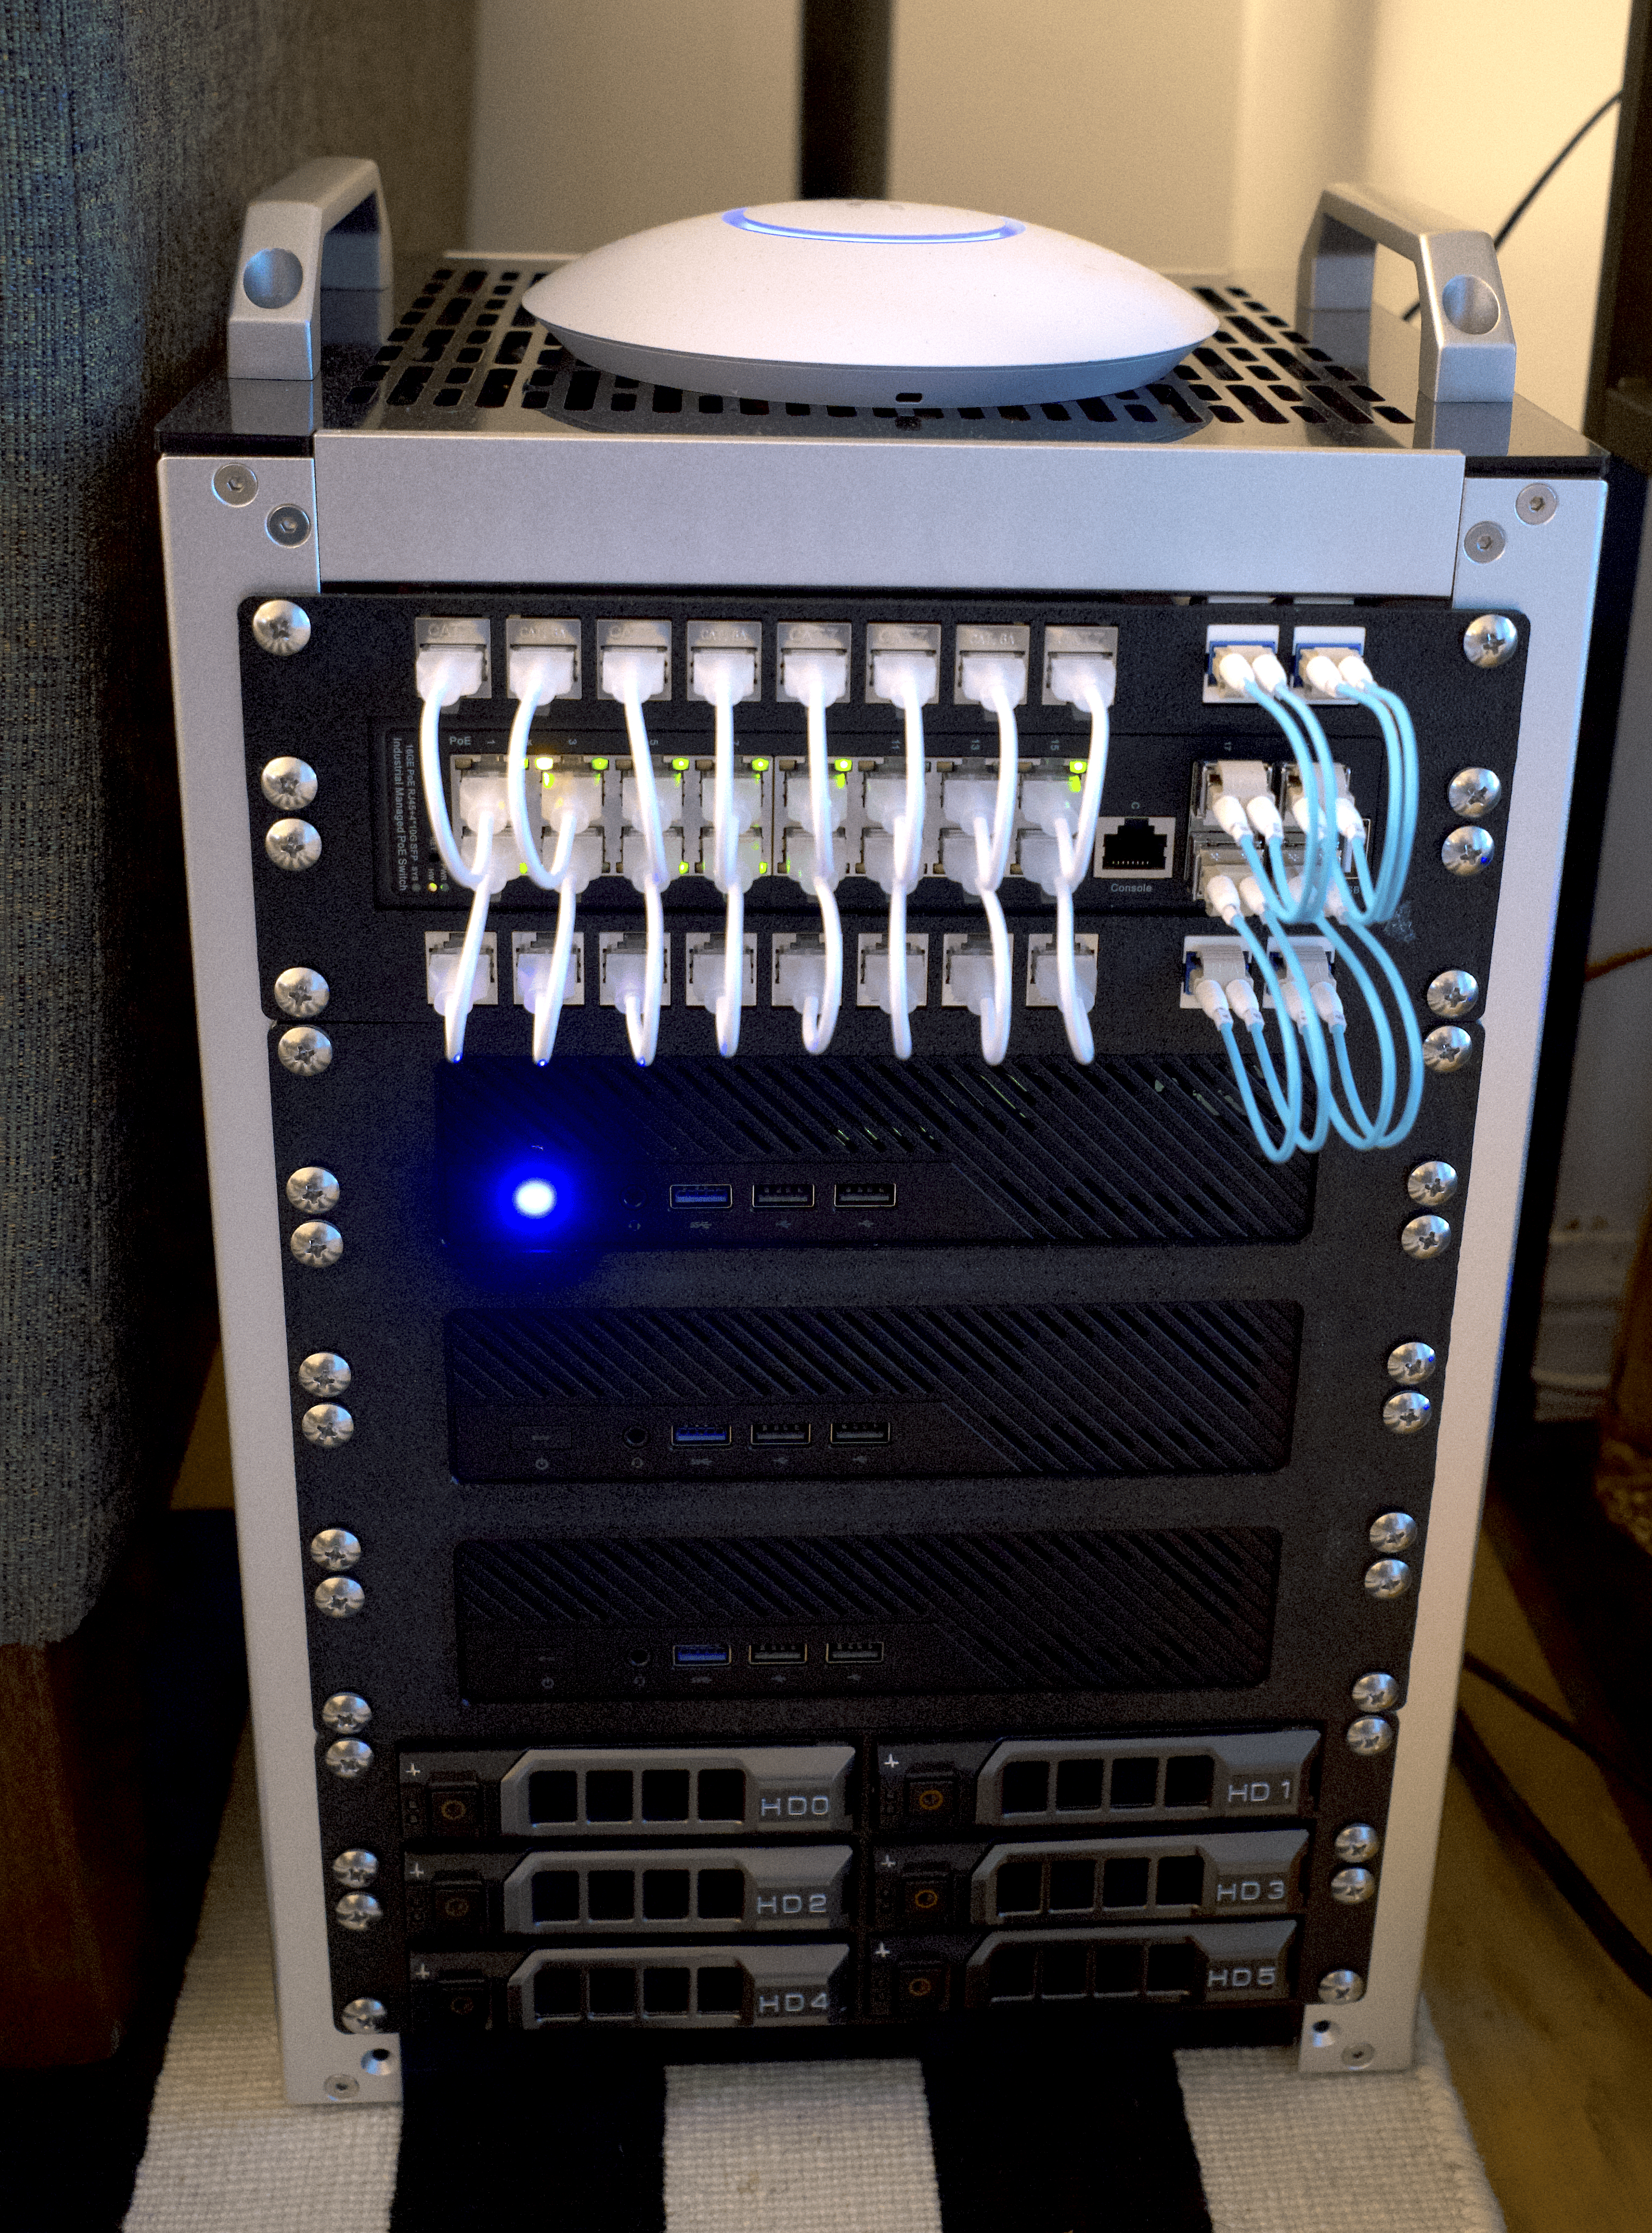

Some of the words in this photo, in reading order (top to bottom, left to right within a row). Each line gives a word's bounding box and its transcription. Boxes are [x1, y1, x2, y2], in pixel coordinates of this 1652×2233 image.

[449, 735, 472, 746] PoE
[650, 738, 659, 746] 5
[891, 739, 900, 749] 11
[970, 739, 980, 750] 13
[1049, 739, 1060, 751] 15
[393, 737, 404, 785] Industrial
[405, 744, 414, 767] 16GE
[406, 769, 416, 786] PoE
[394, 787, 405, 833] Managed
[397, 835, 407, 856] PoE
[410, 843, 419, 862] SFP
[398, 858, 408, 891] Switch
[411, 866, 419, 882] SYS
[1111, 883, 1152, 892] Console
[761, 1795, 830, 1816] HD0
[1207, 1966, 1277, 1988] HD5
